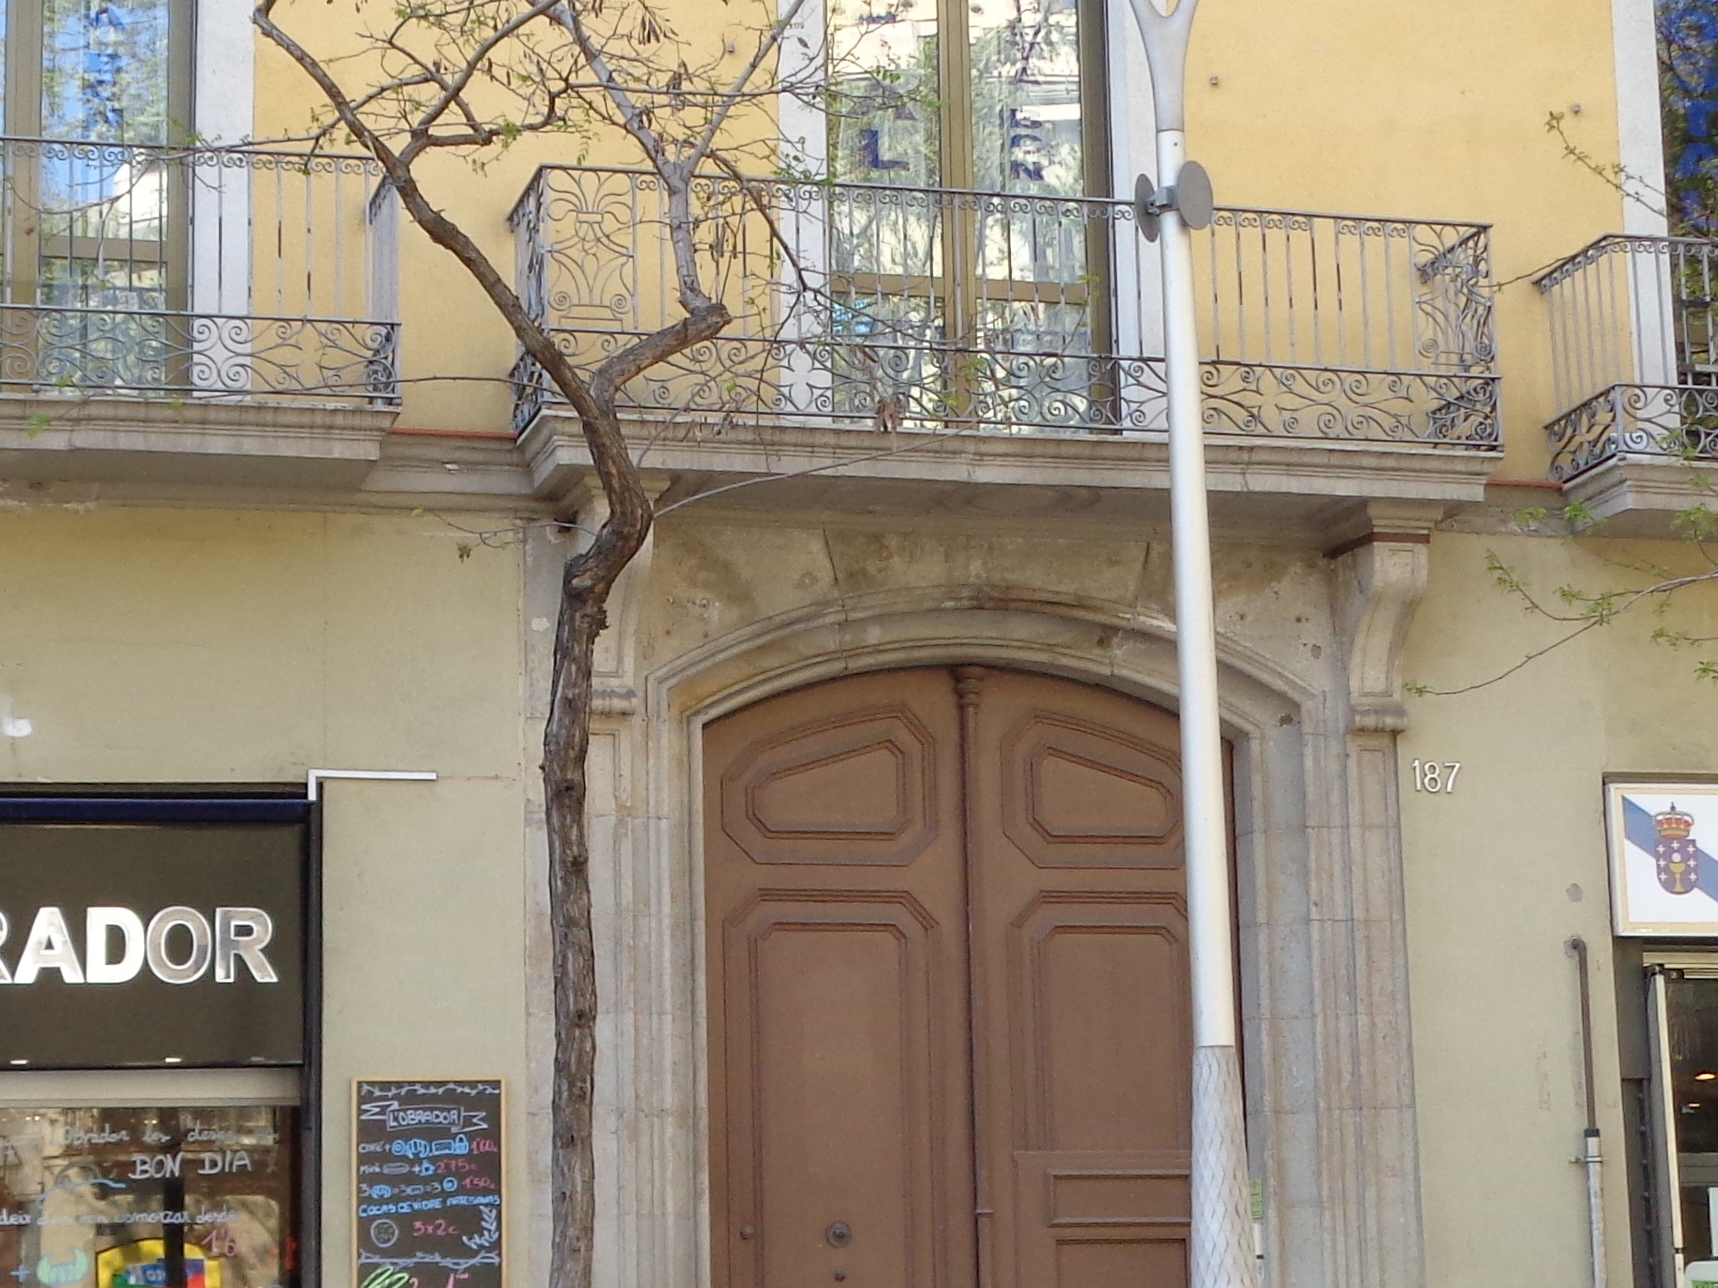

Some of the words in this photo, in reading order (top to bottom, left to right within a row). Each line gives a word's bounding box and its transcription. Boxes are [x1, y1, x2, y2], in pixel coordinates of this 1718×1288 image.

[1411, 757, 1461, 794] 187
[388, 1110, 460, 1129] L'OBRADOR
[127, 1153, 182, 1180] BON
[197, 1150, 253, 1175] DIA
